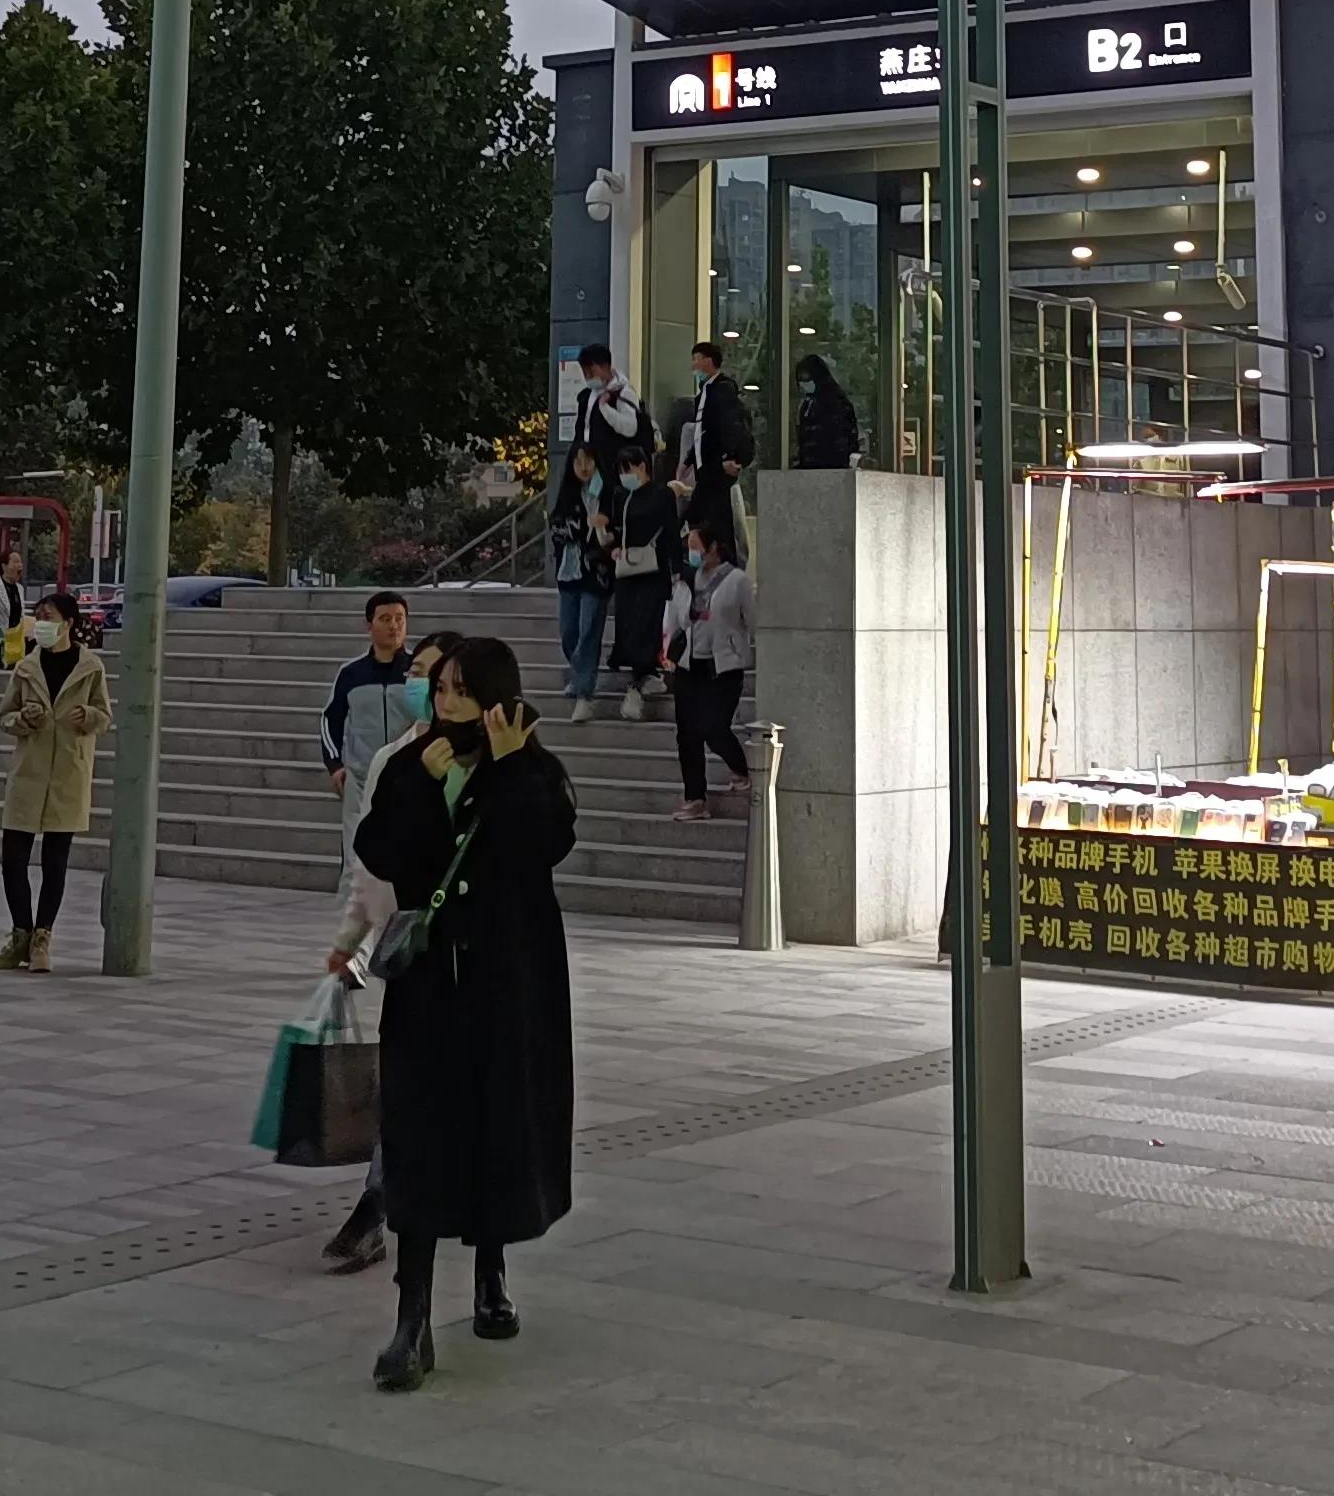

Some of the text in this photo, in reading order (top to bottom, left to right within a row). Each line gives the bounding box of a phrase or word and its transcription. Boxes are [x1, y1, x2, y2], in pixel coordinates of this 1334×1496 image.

[1088, 21, 1187, 73] B2 口
[981, 830, 1159, 877] 种品牌手机
[1172, 847, 1281, 887] 苹果换屏
